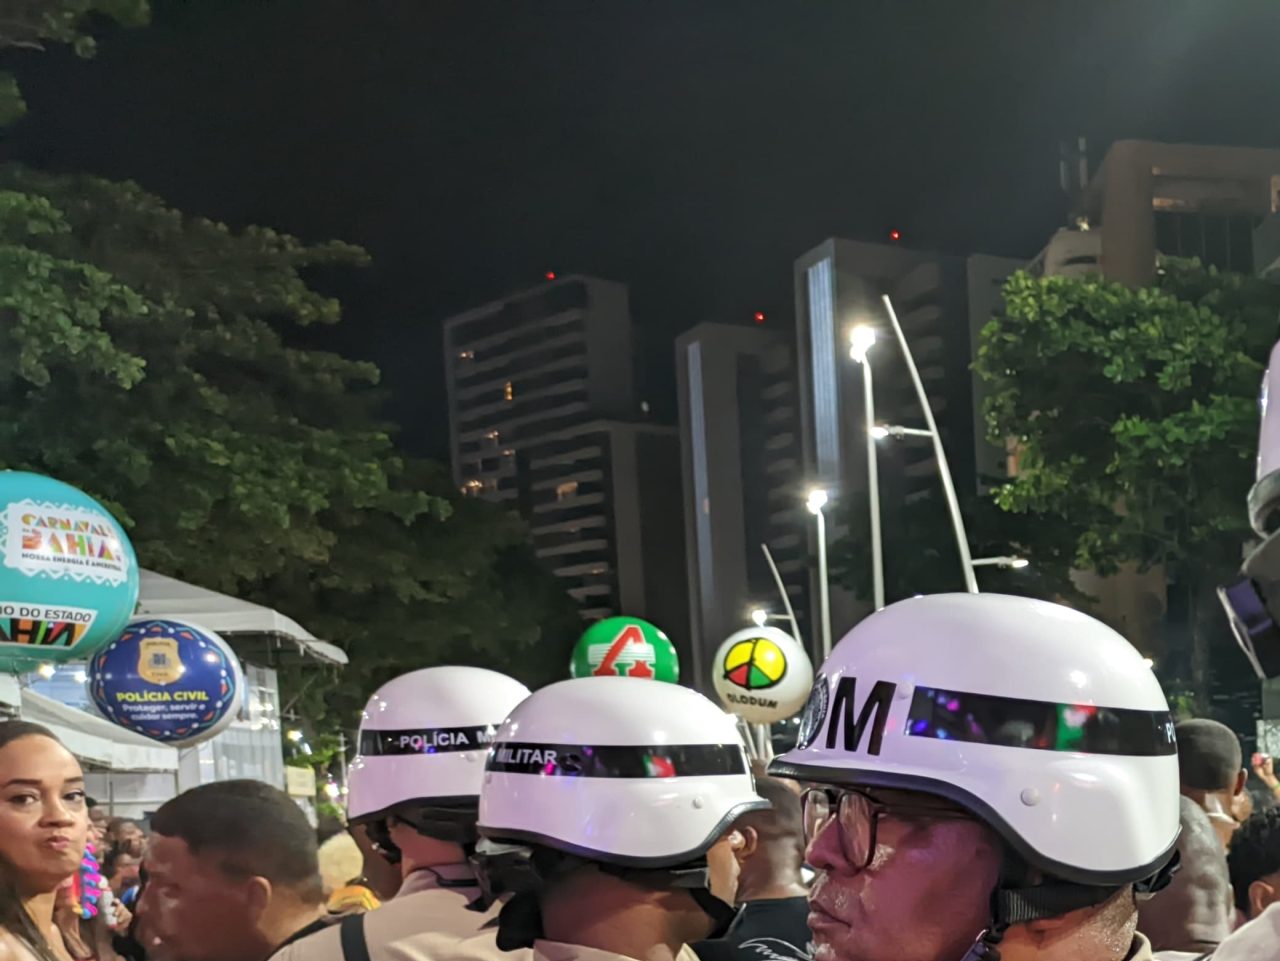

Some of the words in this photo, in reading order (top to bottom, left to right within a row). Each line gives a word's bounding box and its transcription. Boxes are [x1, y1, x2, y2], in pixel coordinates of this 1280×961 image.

[21, 513, 112, 537] CARNAVAL
[21, 529, 115, 562] BAHIA
[52, 555, 84, 567] ENERGIA
[19, 606, 41, 619] DO
[44, 609, 92, 624] ESTADO
[116, 690, 171, 703] POLÍCIA
[173, 691, 209, 702] CIVIL
[400, 732, 469, 751] POLÍCIA
